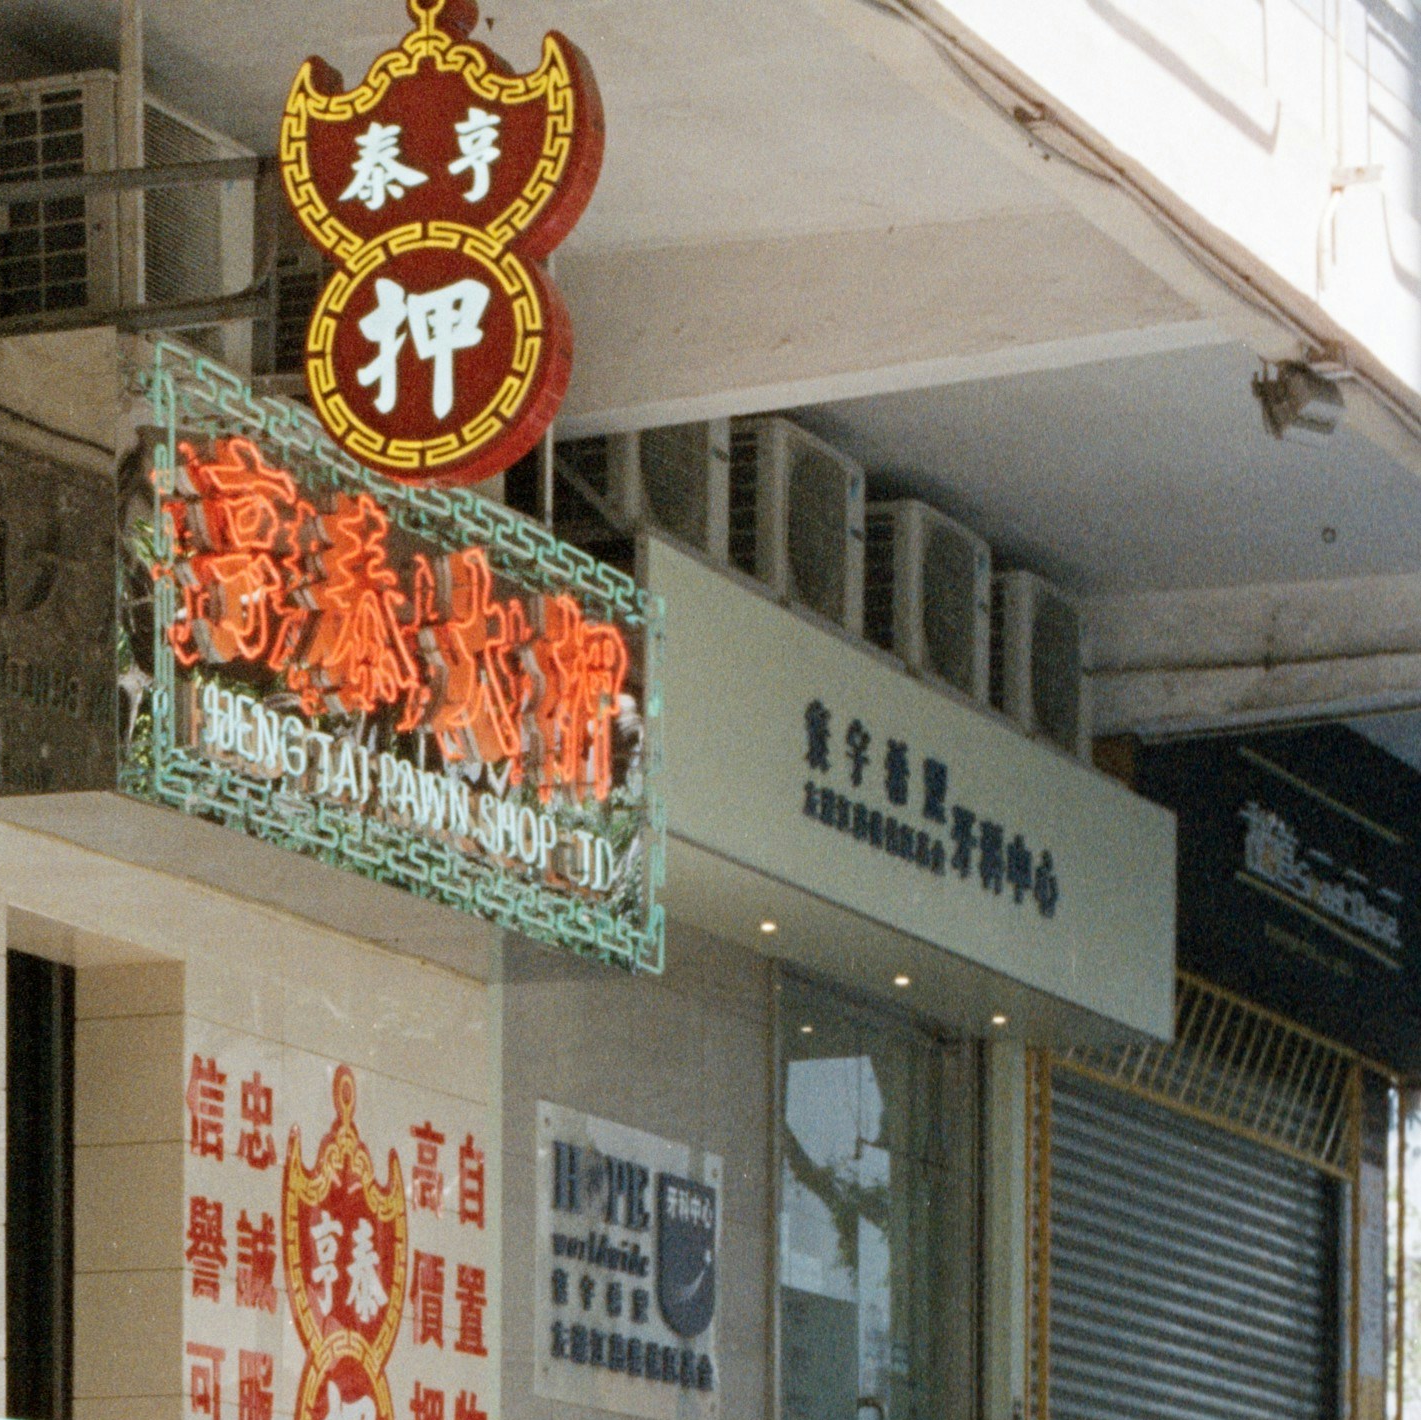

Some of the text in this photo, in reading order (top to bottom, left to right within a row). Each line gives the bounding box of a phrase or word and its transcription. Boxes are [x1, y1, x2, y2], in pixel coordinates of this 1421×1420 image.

[357, 278, 490, 420] 押
[204, 684, 308, 778] HENG
[379, 752, 469, 834] PAWN
[474, 801, 557, 870] SHOP
